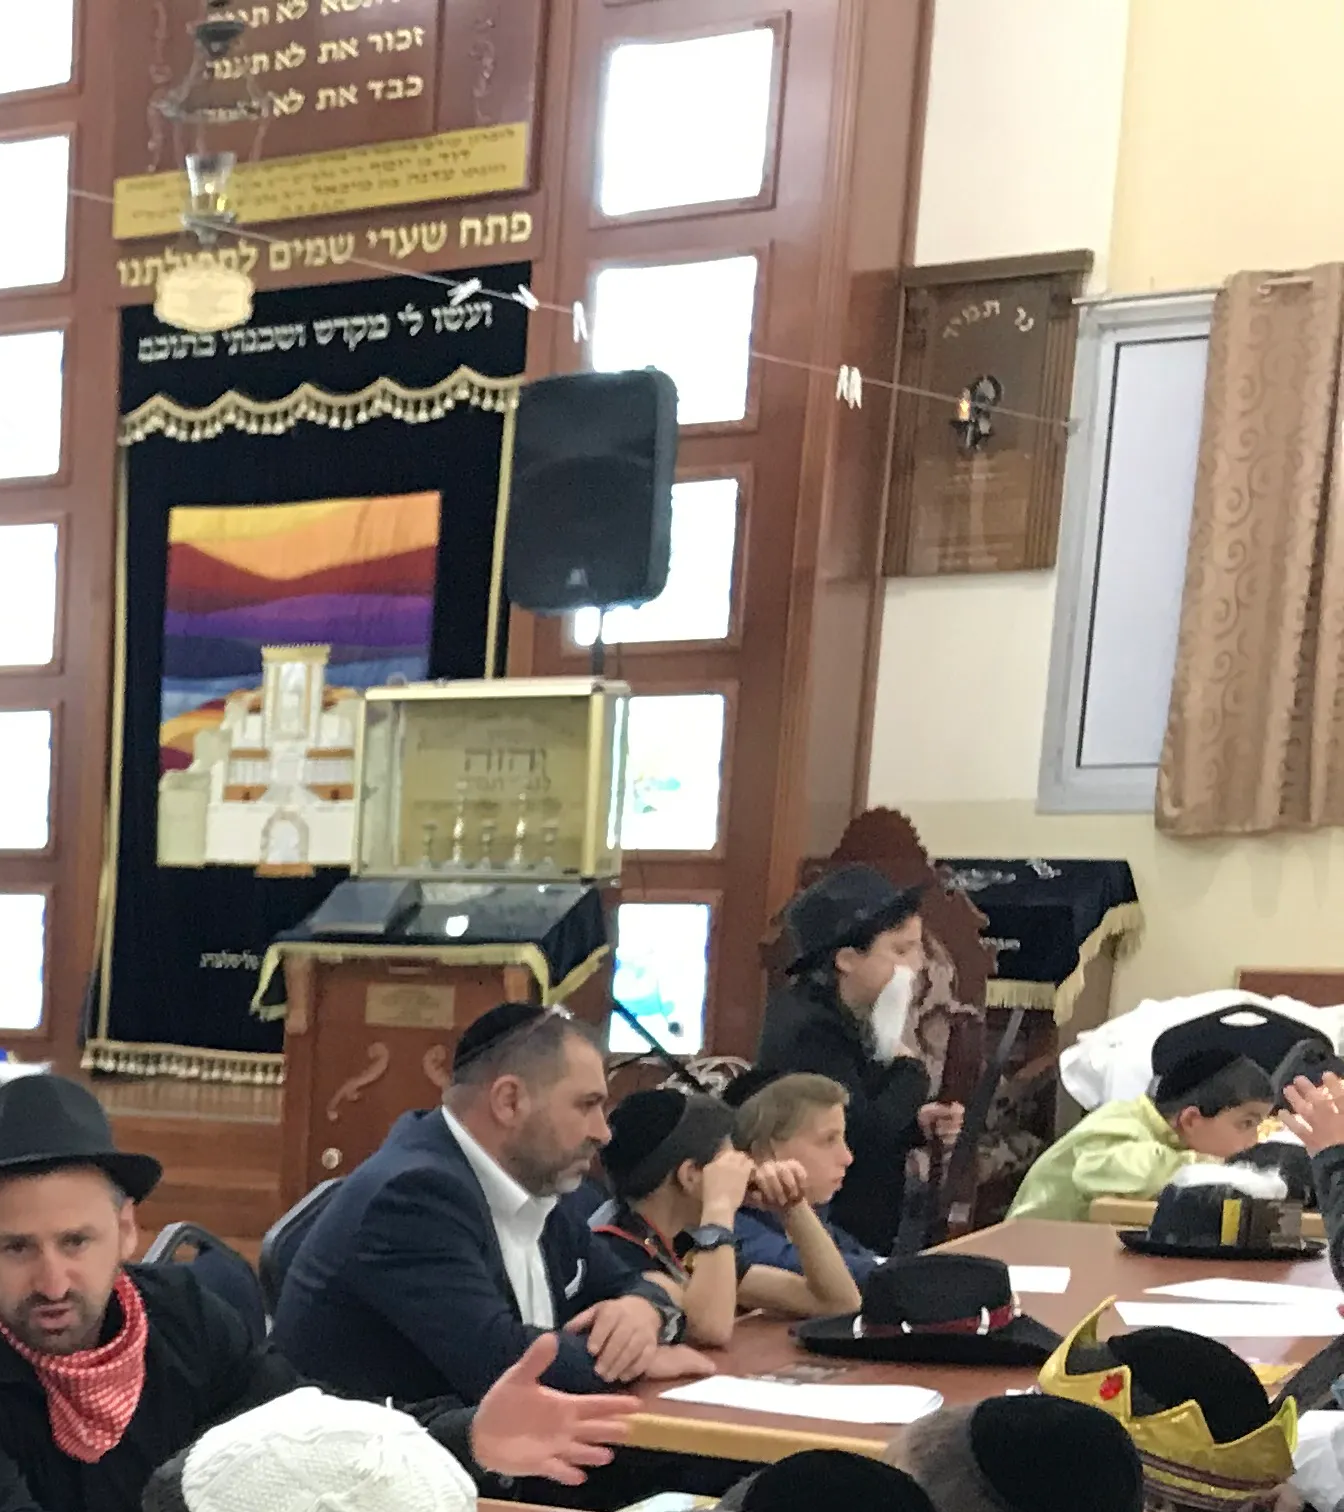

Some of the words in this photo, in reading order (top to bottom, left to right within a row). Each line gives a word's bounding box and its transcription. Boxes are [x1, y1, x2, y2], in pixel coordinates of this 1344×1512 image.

[274, 40, 307, 71] לא
[317, 36, 359, 64] את
[367, 26, 425, 53] זכור
[315, 83, 358, 111] את
[367, 74, 424, 100] כבד
[367, 220, 448, 258] שערי
[459, 211, 533, 248] פתח
[269, 232, 355, 271] שמים
[313, 312, 390, 352] מקדש
[398, 302, 425, 337] לי
[432, 301, 494, 332] ועשו
[138, 332, 217, 364] בתוכם
[222, 322, 308, 356] ושכנתי
